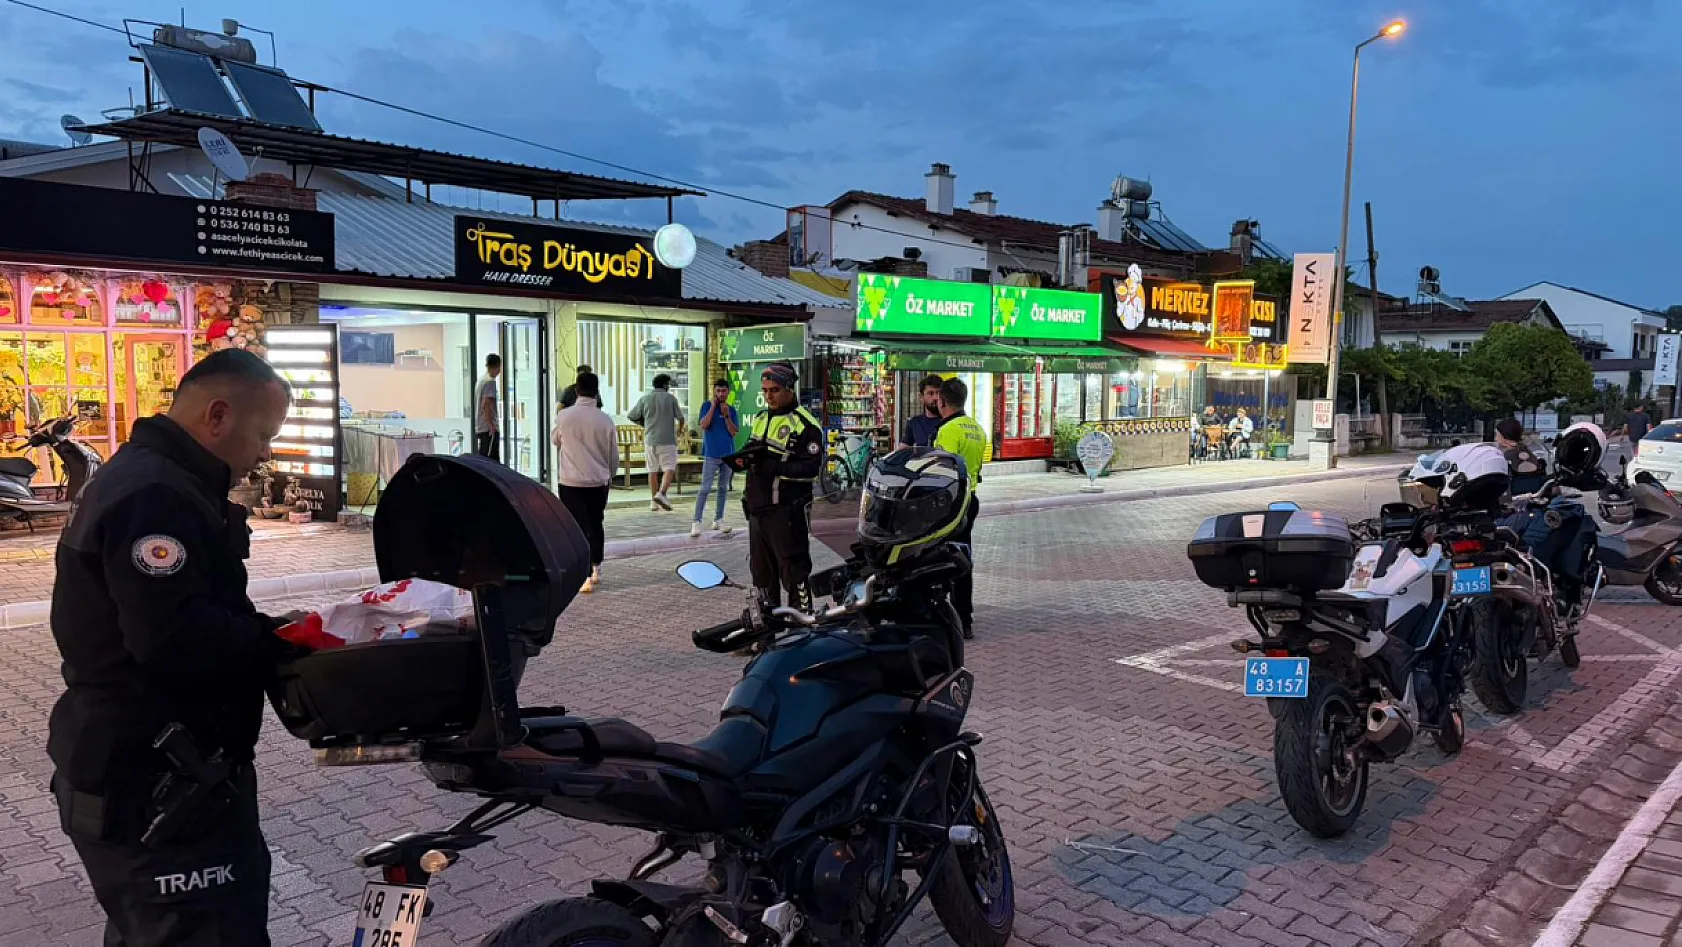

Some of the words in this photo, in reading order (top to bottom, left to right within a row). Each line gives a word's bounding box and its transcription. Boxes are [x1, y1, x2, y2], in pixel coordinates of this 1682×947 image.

[210, 206, 217, 215] 0
[220, 207, 239, 217] 252
[241, 208, 260, 219] 614
[262, 211, 275, 220] 83
[277, 213, 290, 222] 63
[211, 218, 217, 228] 0
[220, 219, 239, 230] 536
[242, 221, 261, 232] 740
[263, 223, 275, 233] 83
[277, 225, 290, 234] 63
[482, 271, 509, 283] HAIR
[509, 273, 553, 287] DRESSER
[905, 293, 923, 314] ÖZ
[926, 300, 974, 318] MARKET
[1151, 286, 1210, 315] MERKEZ
[1031, 302, 1045, 322] ÖZ
[1047, 308, 1087, 324] MARKET
[763, 330, 774, 342] ÖZ
[753, 344, 783, 355] MARKET
[946, 357, 956, 367] ÖZ
[957, 358, 985, 369] MARKET
[1250, 662, 1268, 676] 48
[1295, 662, 1304, 676] A
[1256, 678, 1304, 693] 83157
[364, 889, 386, 919] 48
[395, 892, 421, 925] FK
